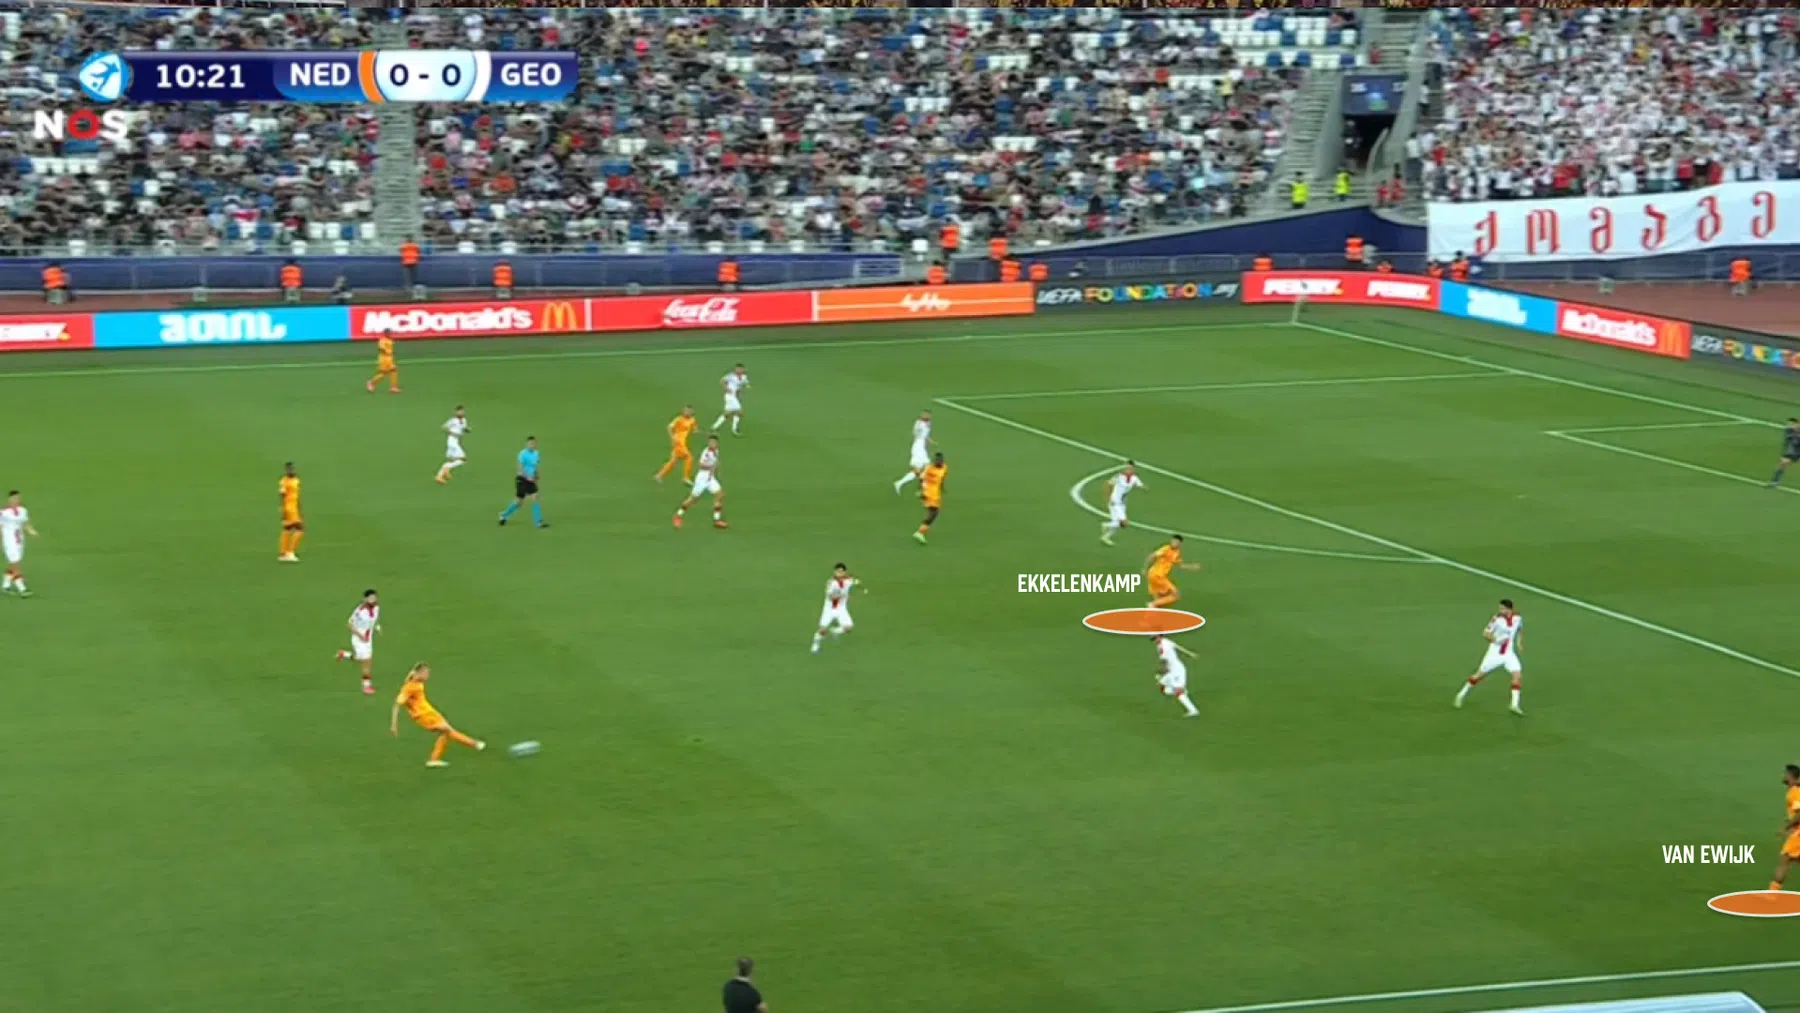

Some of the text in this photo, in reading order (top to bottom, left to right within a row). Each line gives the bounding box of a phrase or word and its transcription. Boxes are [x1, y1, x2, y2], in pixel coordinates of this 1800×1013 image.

[1036, 282, 1213, 304] UEFA FOUNDATION
[363, 307, 533, 333] McDonald's
